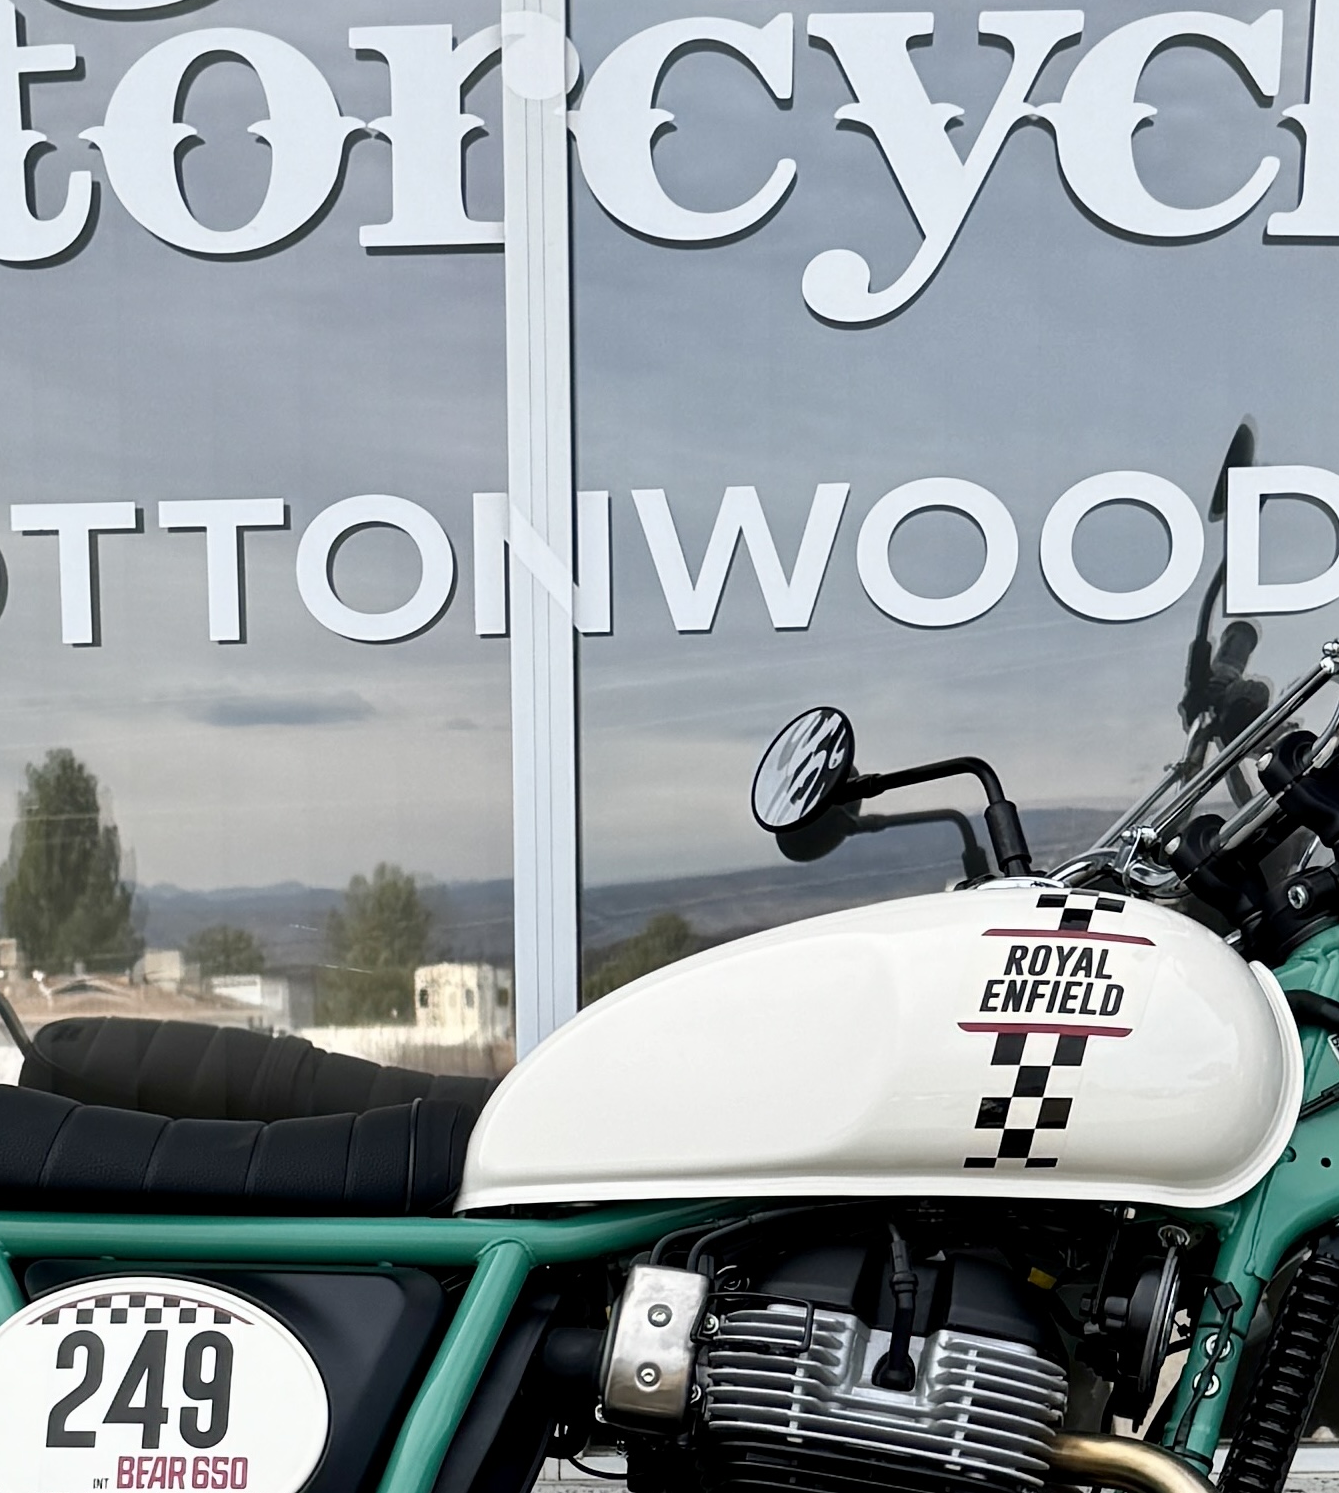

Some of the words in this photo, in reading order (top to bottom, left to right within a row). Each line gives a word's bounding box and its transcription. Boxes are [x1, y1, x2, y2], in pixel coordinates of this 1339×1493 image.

[1003, 945, 1113, 980] ROYAL
[979, 980, 1125, 1016] ENFIELD
[46, 1329, 234, 1450] 249
[93, 1478, 110, 1489] INT
[116, 1456, 187, 1489] BEAR
[192, 1456, 248, 1489] 650
